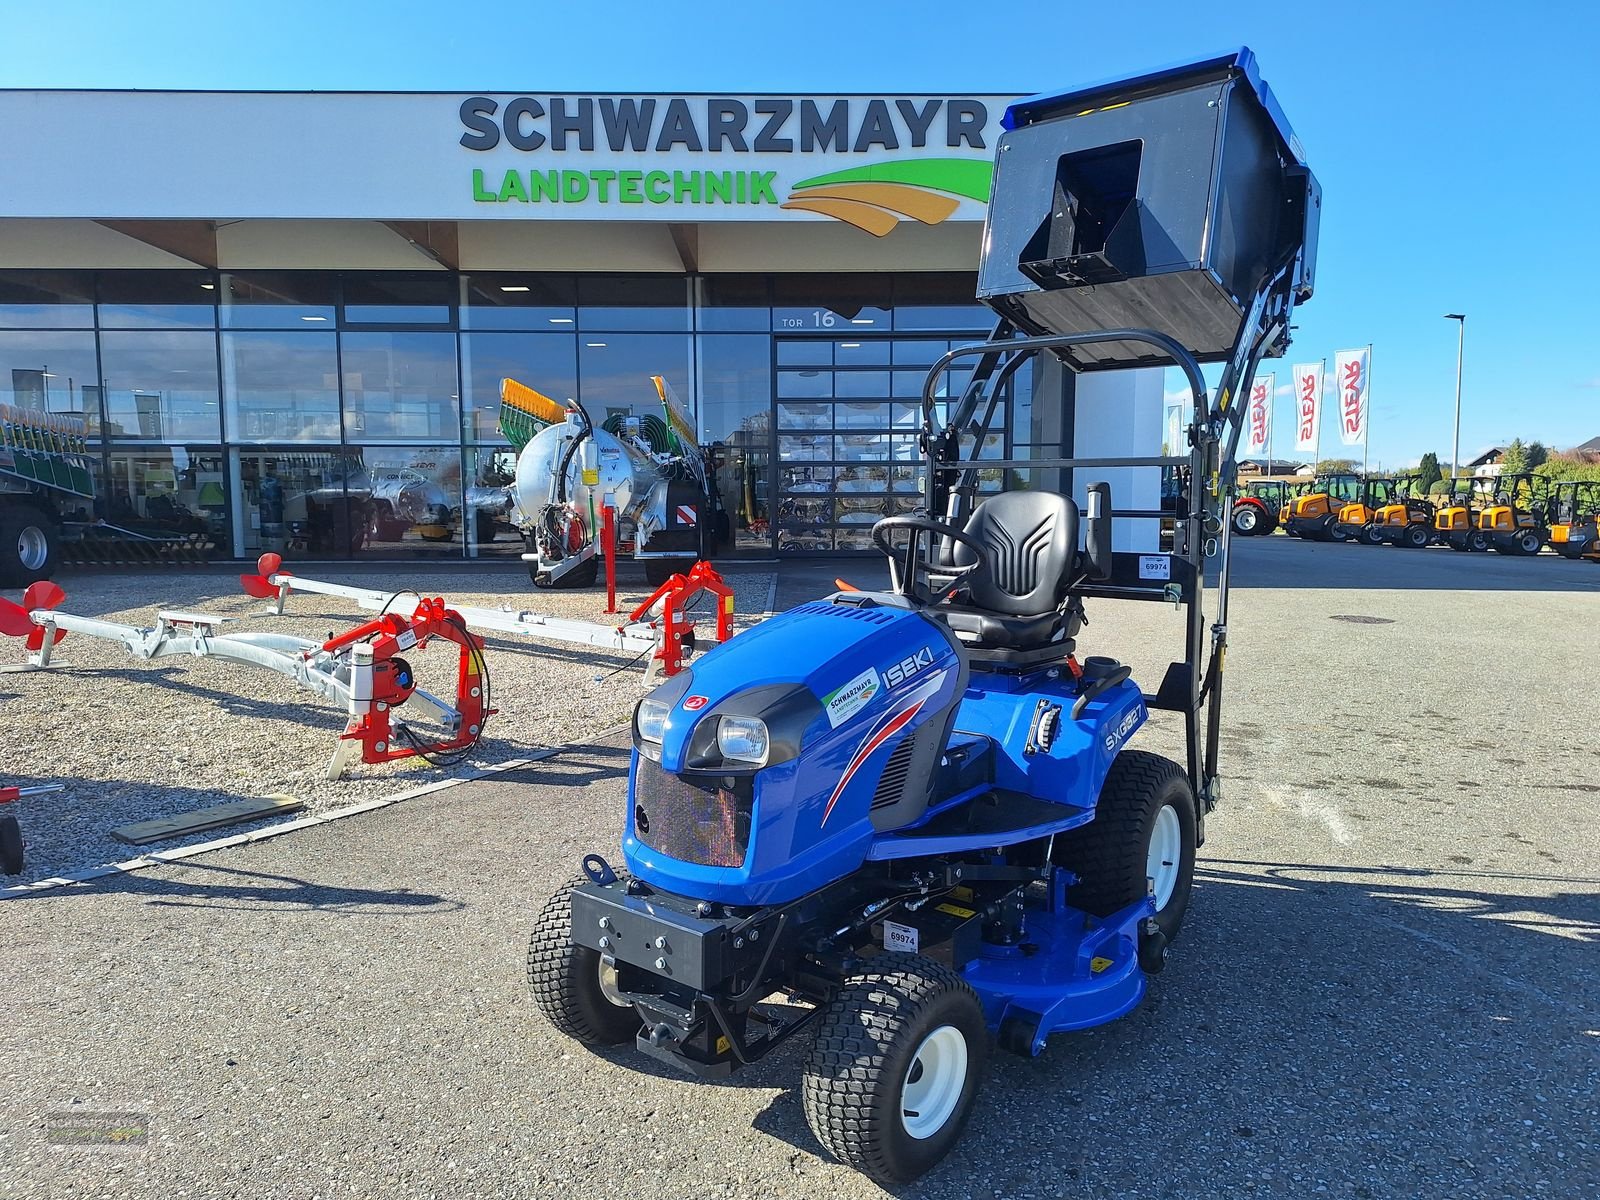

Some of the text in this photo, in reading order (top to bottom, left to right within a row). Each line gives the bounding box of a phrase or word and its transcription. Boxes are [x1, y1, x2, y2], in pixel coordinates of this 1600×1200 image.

[459, 97, 988, 153] SCHWARZMAYR
[473, 169, 778, 204] LANDTECHNIK
[782, 310, 835, 328] TOR 16
[881, 645, 934, 690] ISEKI
[830, 678, 872, 709] SCHWARZMAYR
[1105, 703, 1142, 750] SXG327
[891, 931, 915, 945] 69974
